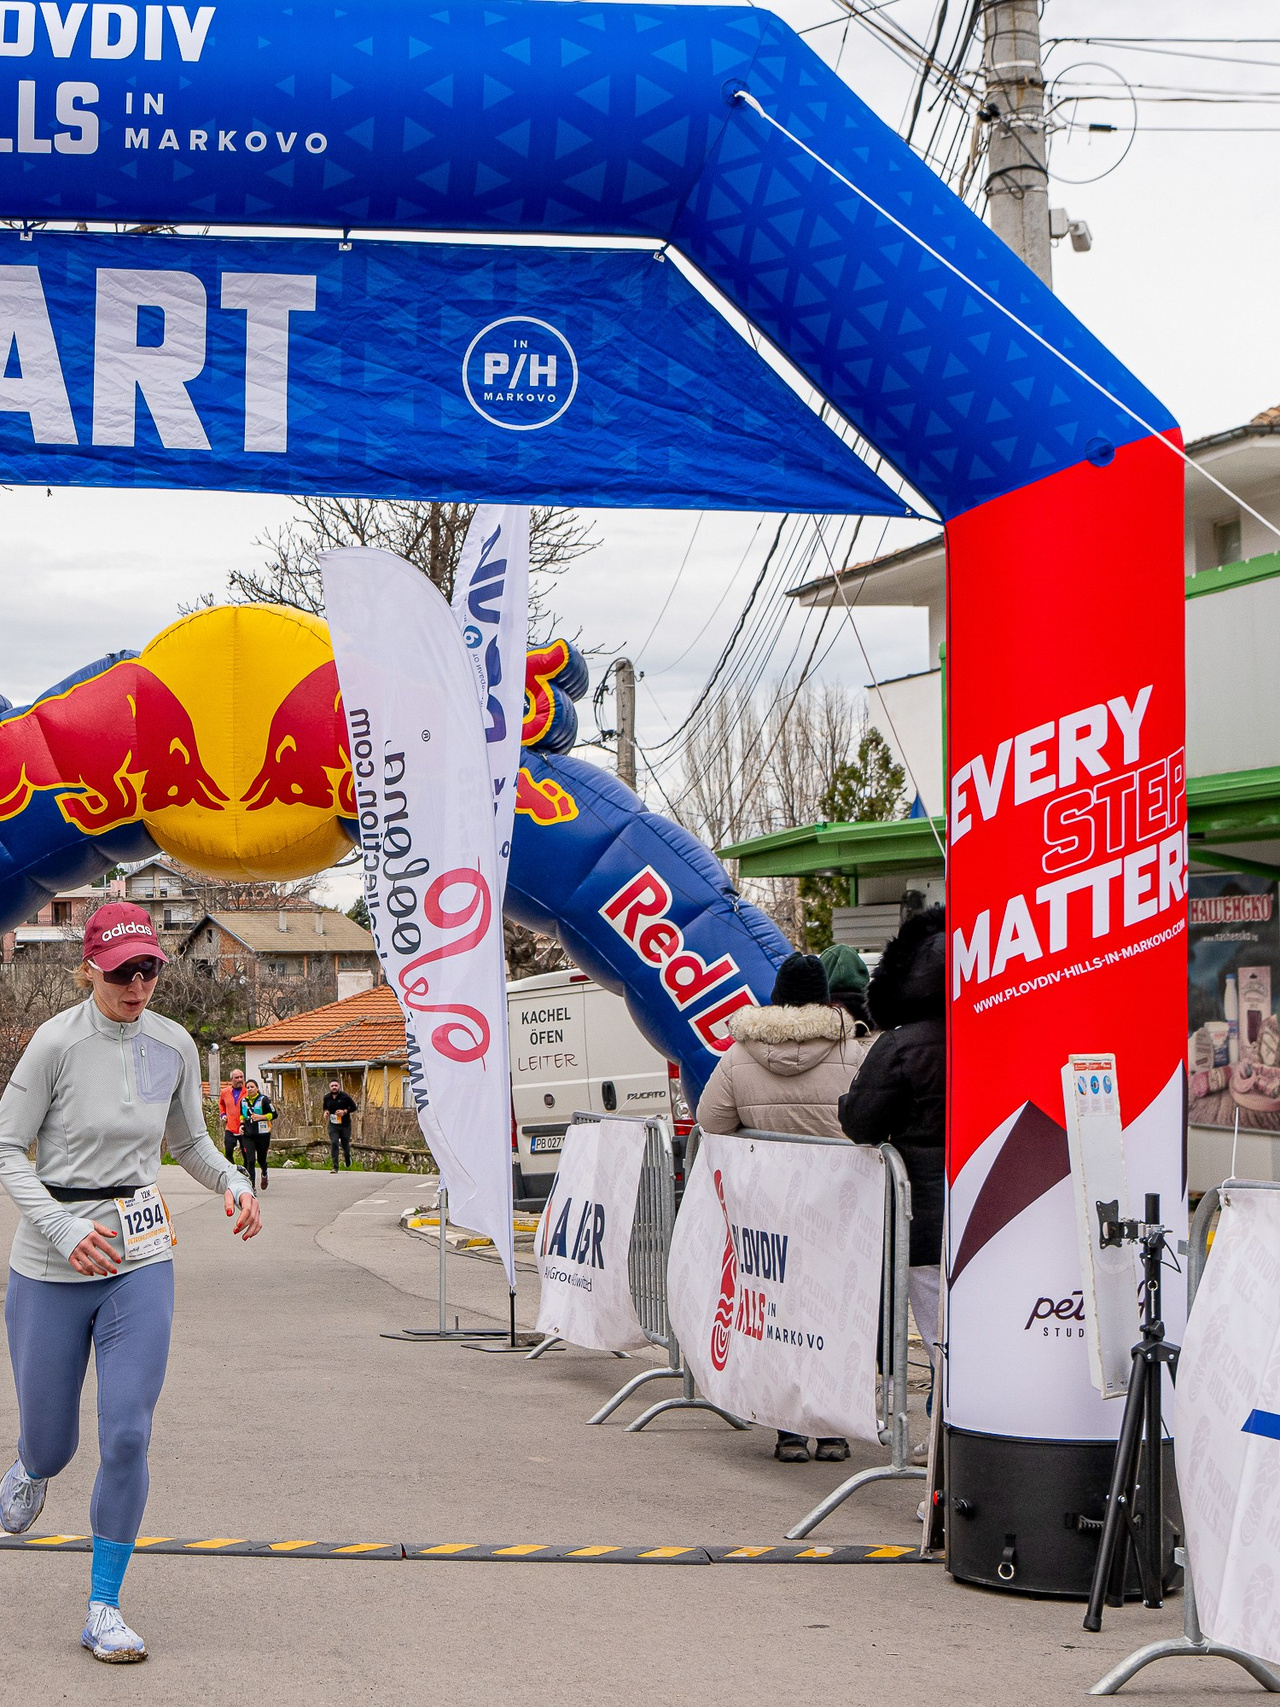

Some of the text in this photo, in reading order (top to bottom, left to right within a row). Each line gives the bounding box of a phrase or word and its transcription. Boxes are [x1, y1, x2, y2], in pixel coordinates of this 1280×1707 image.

[125, 92, 164, 115] IN
[124, 128, 328, 154] MARKOVO
[513, 339, 528, 348] IN
[484, 353, 557, 389] P/H
[483, 392, 556, 403] MARKOVO
[950, 684, 1153, 847] EVERY
[1042, 746, 1186, 873] STEP
[101, 921, 153, 942] adidas
[603, 870, 734, 1006] Red
[974, 917, 1186, 1014] WWW.PLOVDIV-HILLS-IN-MARKOVO.COM
[521, 1007, 571, 1025] KACHEL
[530, 1029, 563, 1046] ÖFEN
[518, 1053, 578, 1072] LEITER
[627, 1090, 667, 1101] DUCATO
[124, 1203, 164, 1236] 1294
[767, 1302, 777, 1317] IN
[767, 1325, 824, 1350] MARKOVO
[1043, 1327, 1085, 1338] STUD
